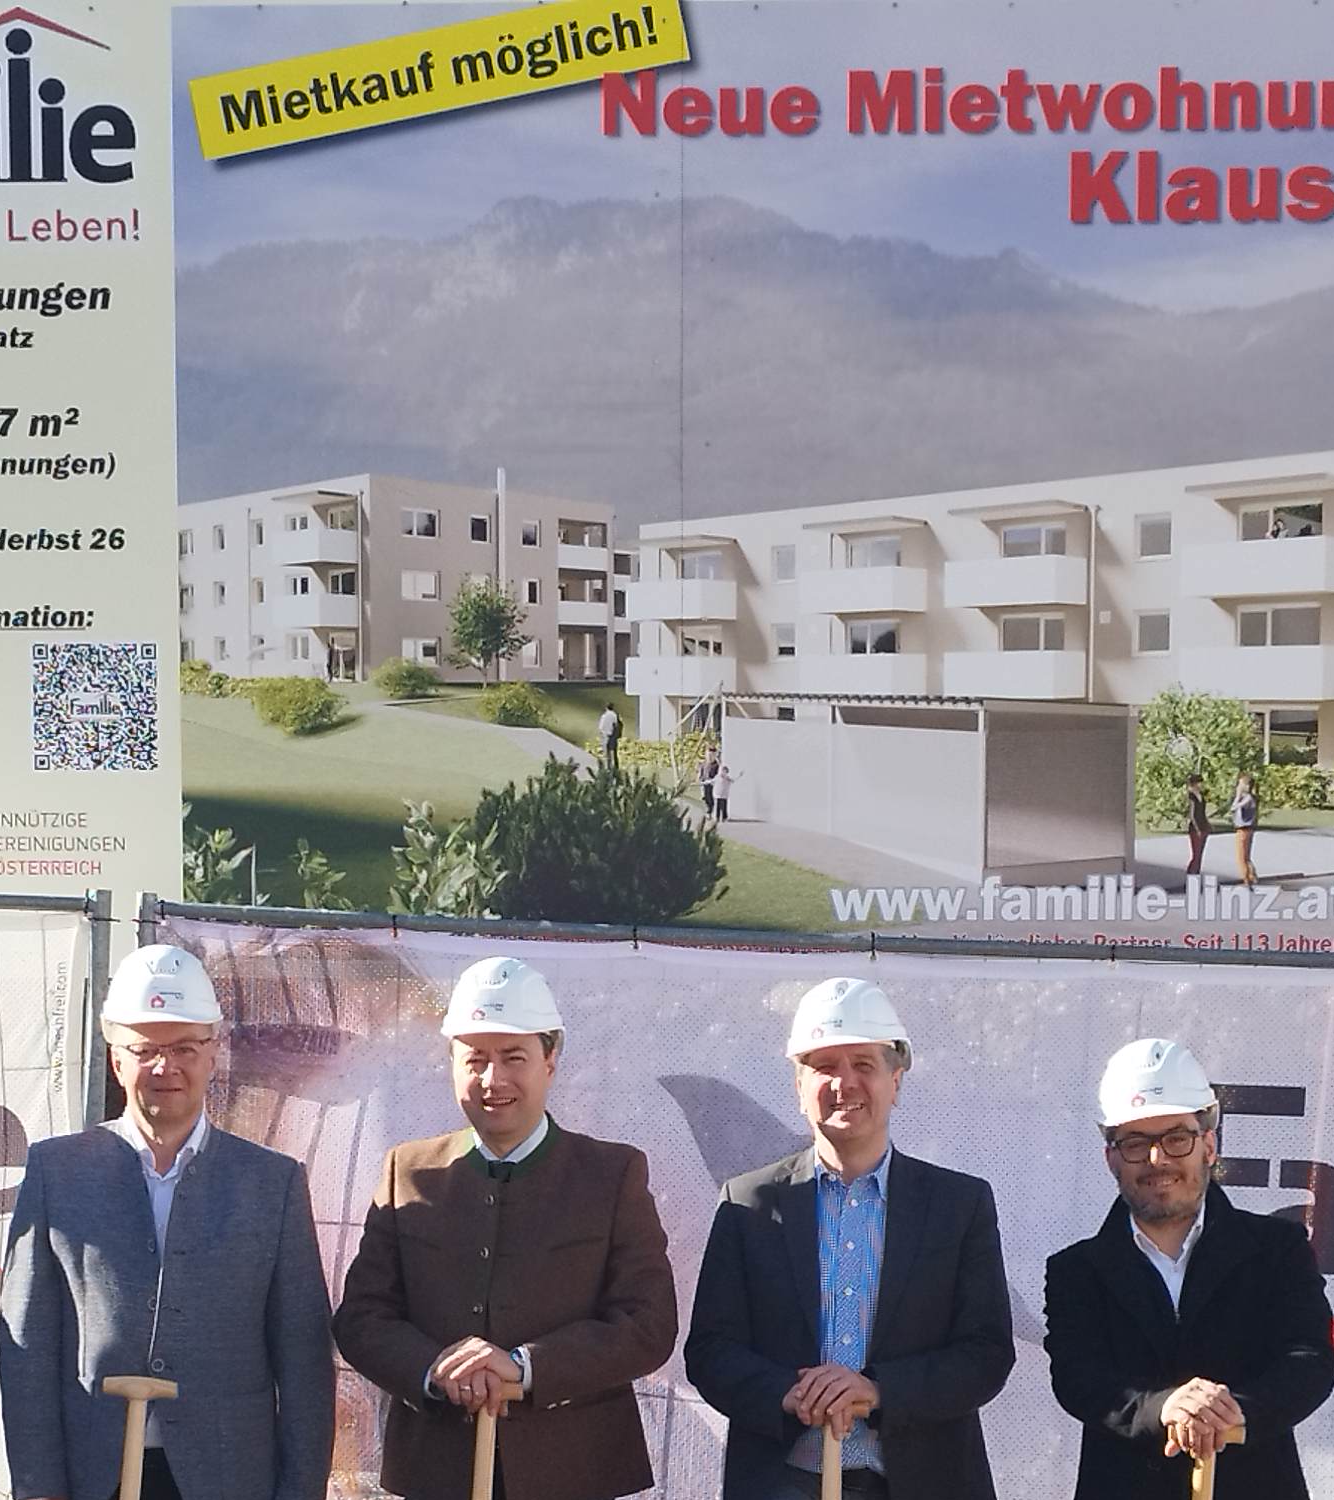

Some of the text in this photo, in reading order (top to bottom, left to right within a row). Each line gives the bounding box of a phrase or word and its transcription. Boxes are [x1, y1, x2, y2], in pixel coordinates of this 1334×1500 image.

[219, 5, 660, 136] Mietkauf möglich!
[600, 70, 821, 138] Neue
[7, 208, 140, 242] Leben!
[28, 406, 80, 438] m²
[89, 527, 126, 551] 26
[1182, 932, 1225, 951] Seit
